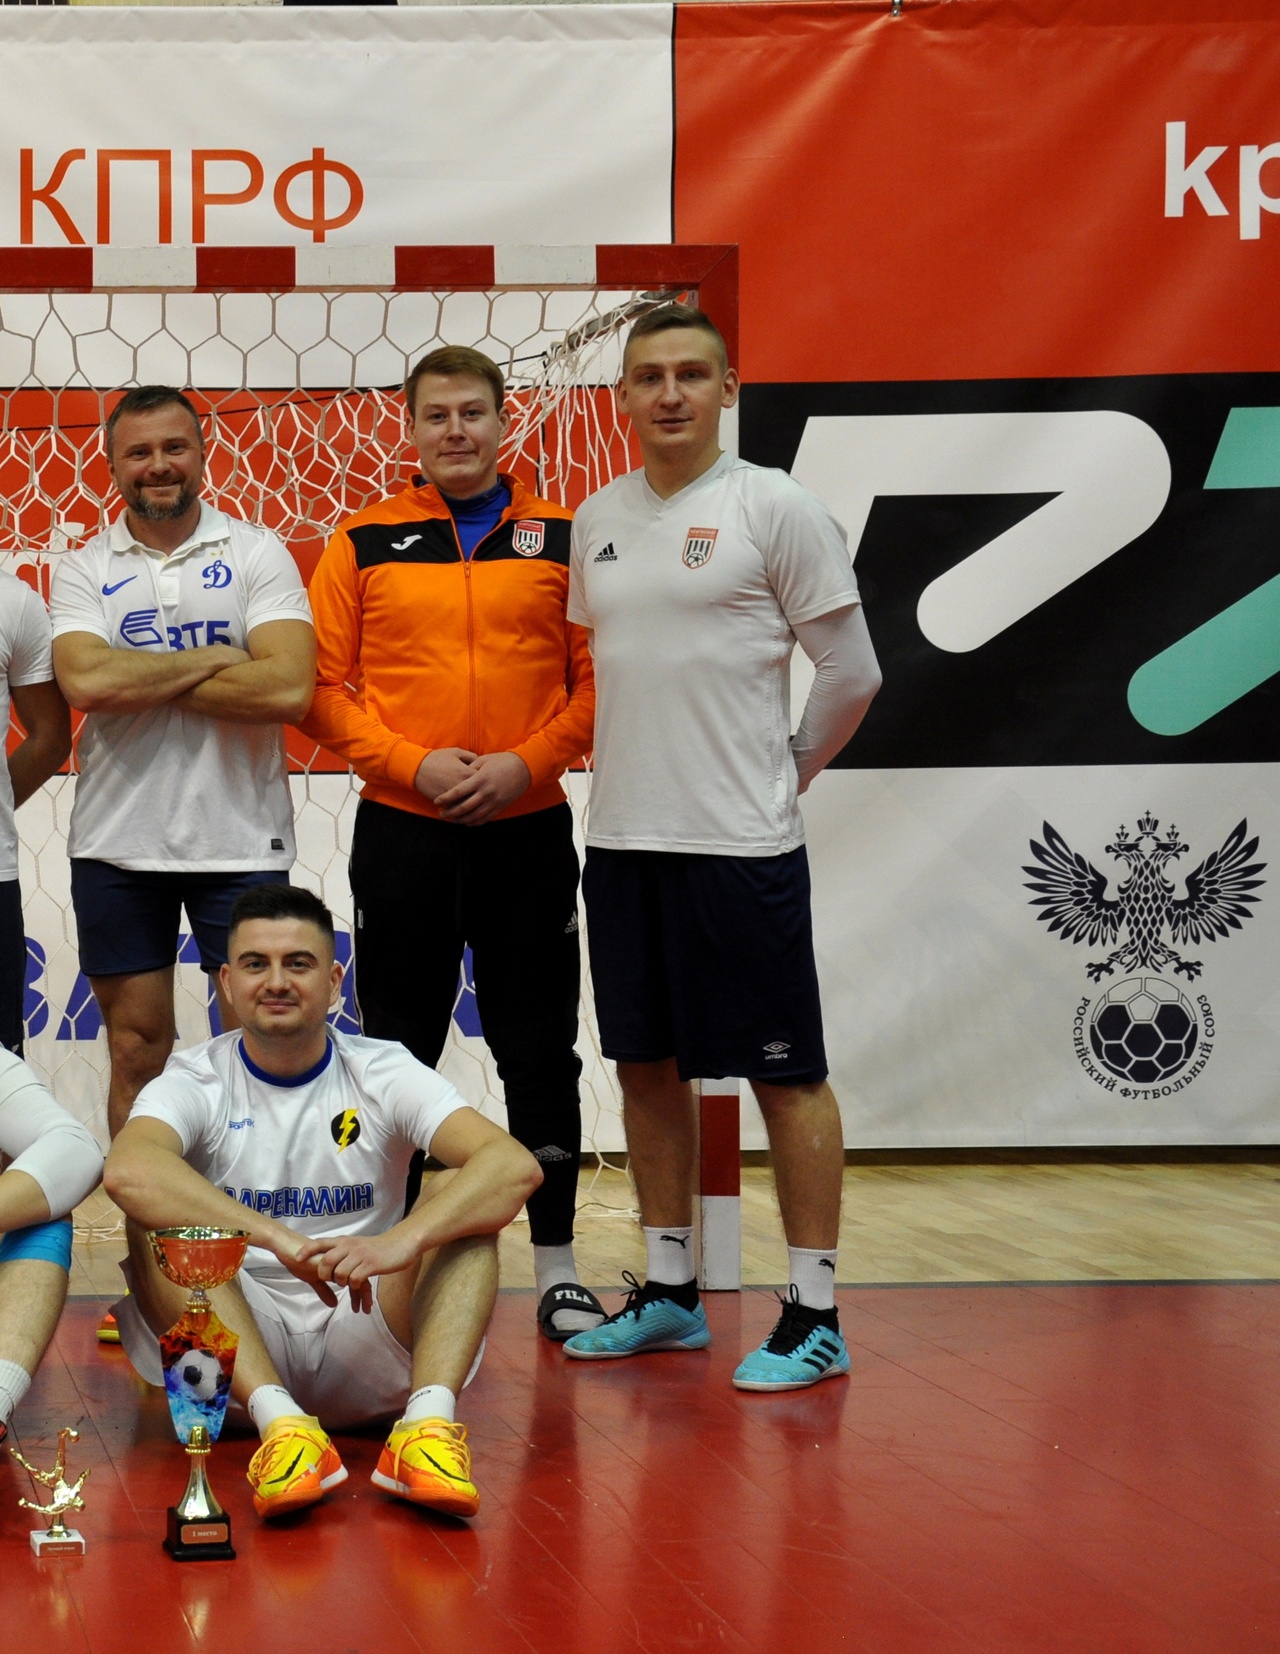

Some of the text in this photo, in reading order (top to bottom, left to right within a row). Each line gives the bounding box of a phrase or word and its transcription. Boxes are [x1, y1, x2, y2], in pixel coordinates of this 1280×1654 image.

[20, 147, 364, 245] КПРФ
[764, 1052, 788, 1060] umbro
[1073, 994, 1215, 1100] РОССИЙСКИЙ ФУТБОЛЬНЫЙ СОЮЗ
[554, 1289, 593, 1305] FILA
